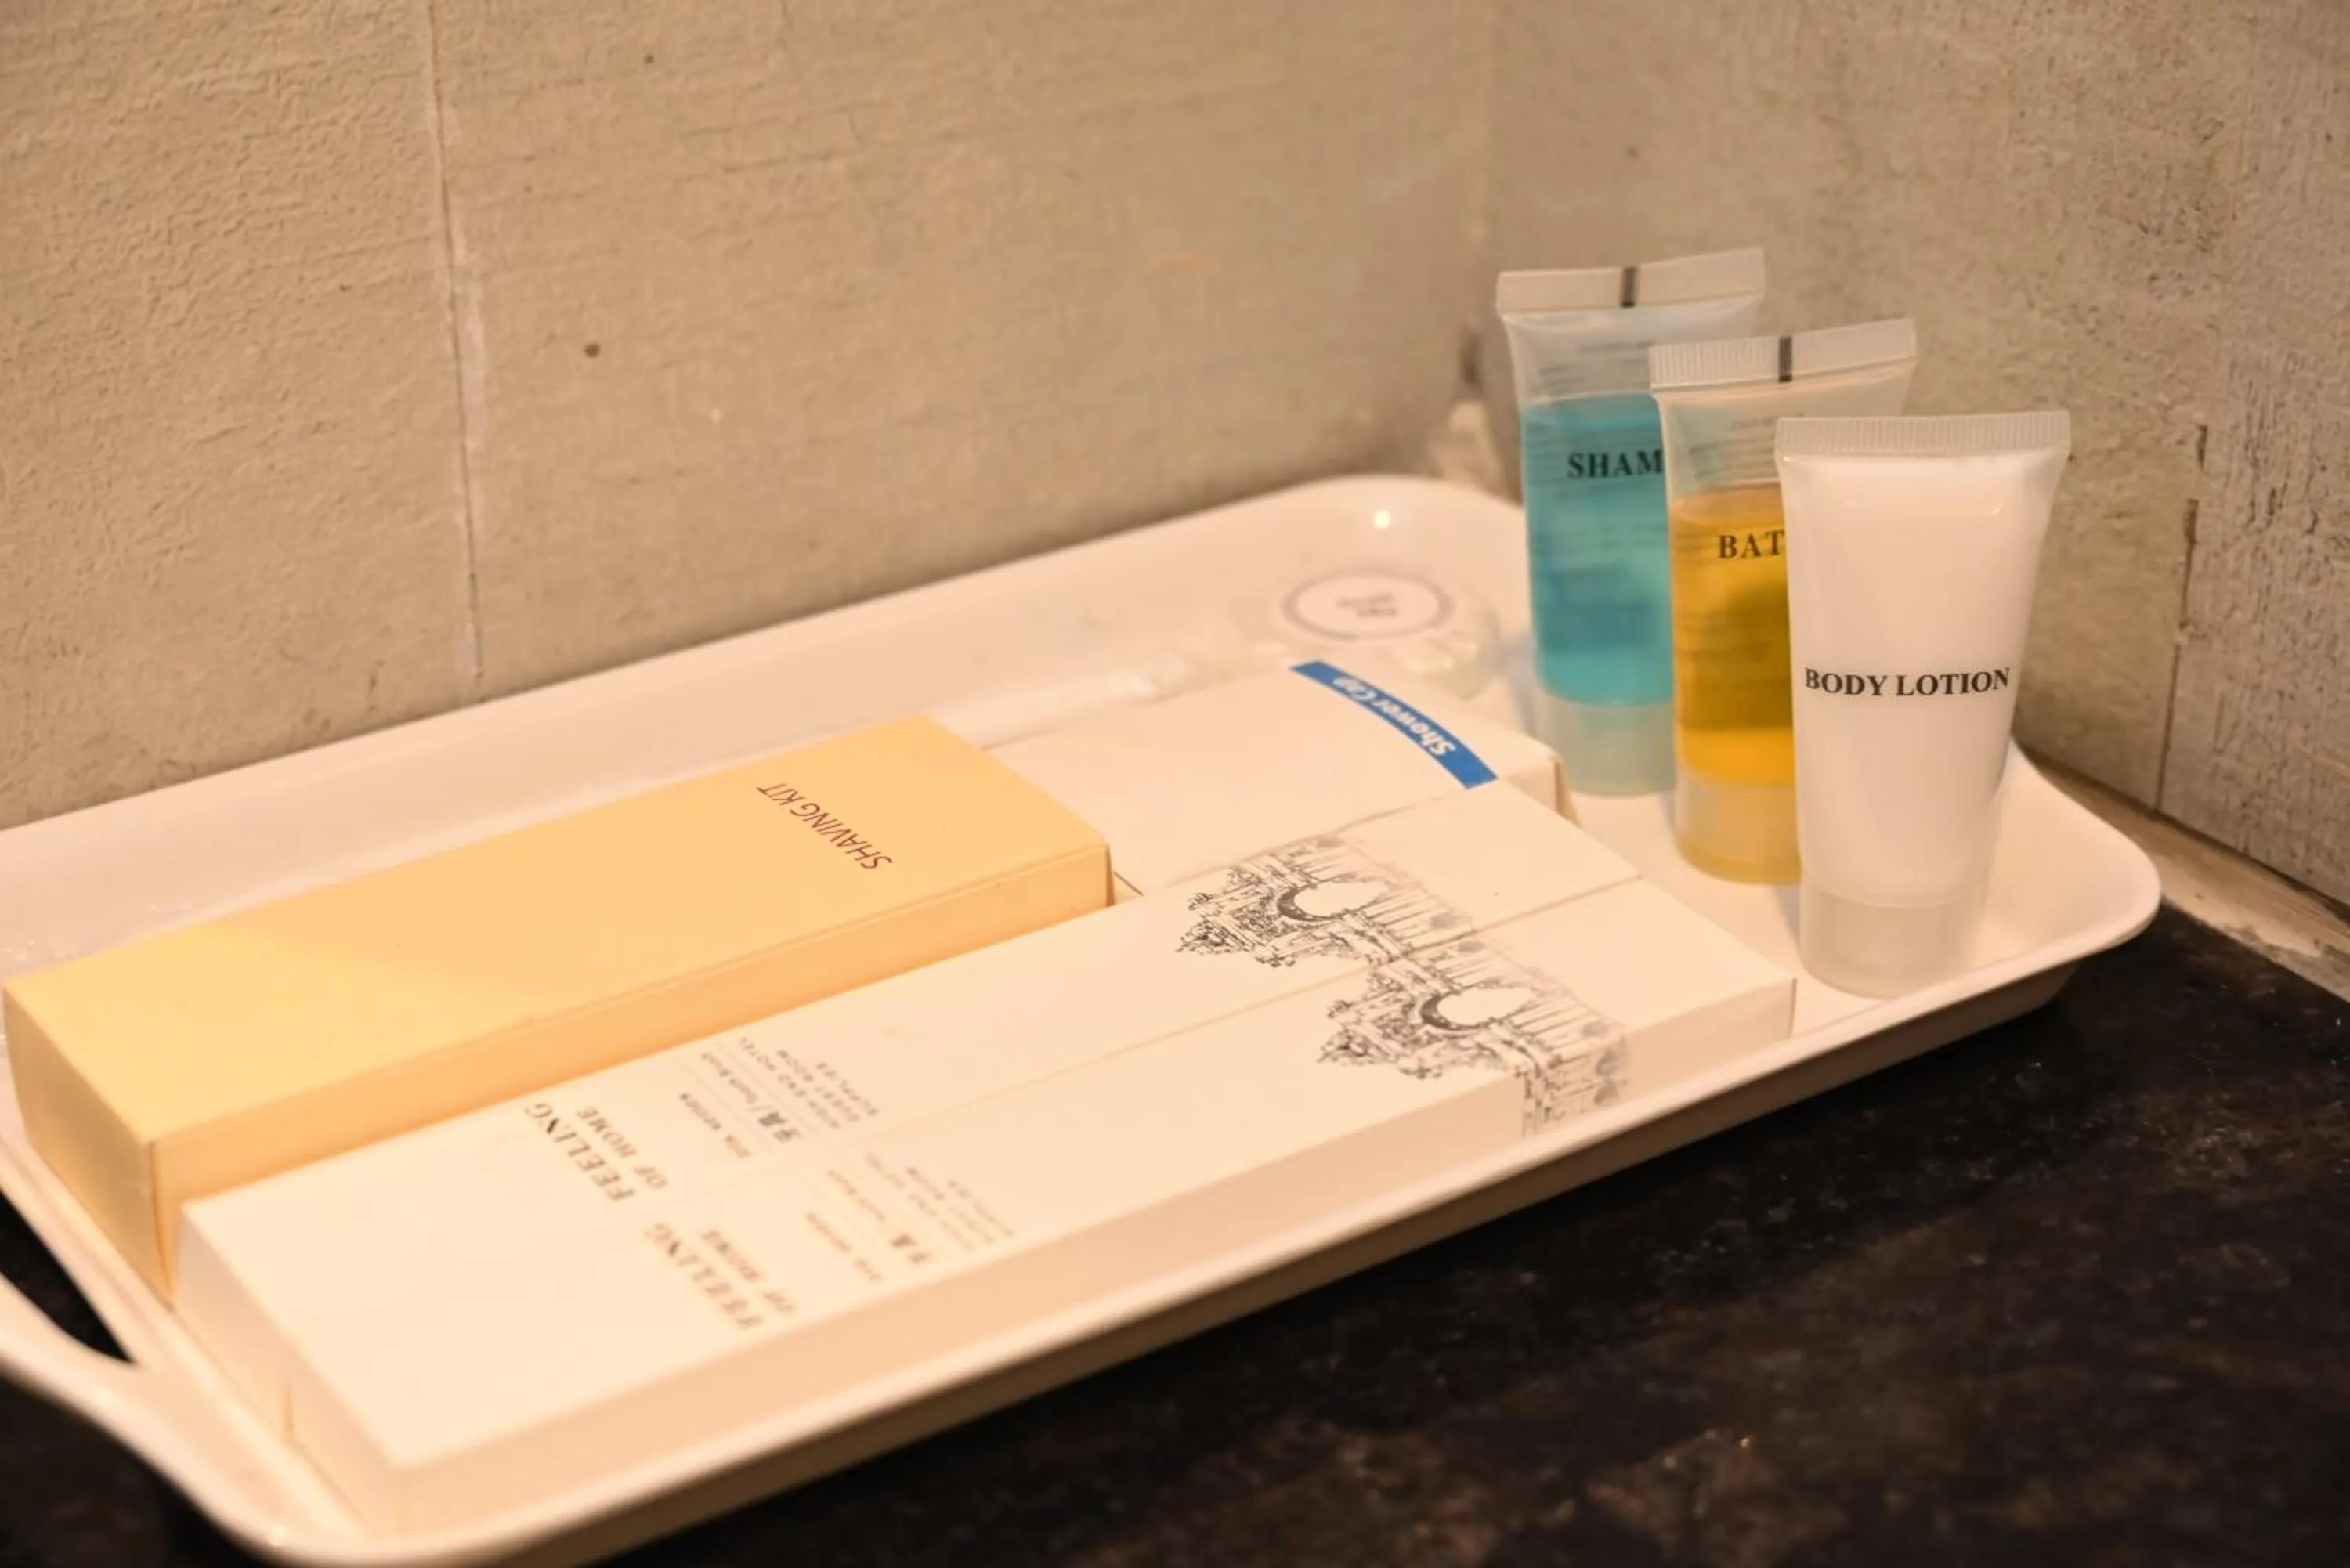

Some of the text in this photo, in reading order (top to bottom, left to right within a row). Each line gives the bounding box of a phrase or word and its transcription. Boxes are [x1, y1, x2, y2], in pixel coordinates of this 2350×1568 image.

[1567, 449, 1662, 479] SHAM
[1718, 529, 1785, 558] BAT
[1804, 667, 2010, 696] BODY LOTION
[756, 783, 893, 869] SHAVING KIT
[524, 1102, 635, 1201] FEELING
[577, 1106, 667, 1188] OF HOME
